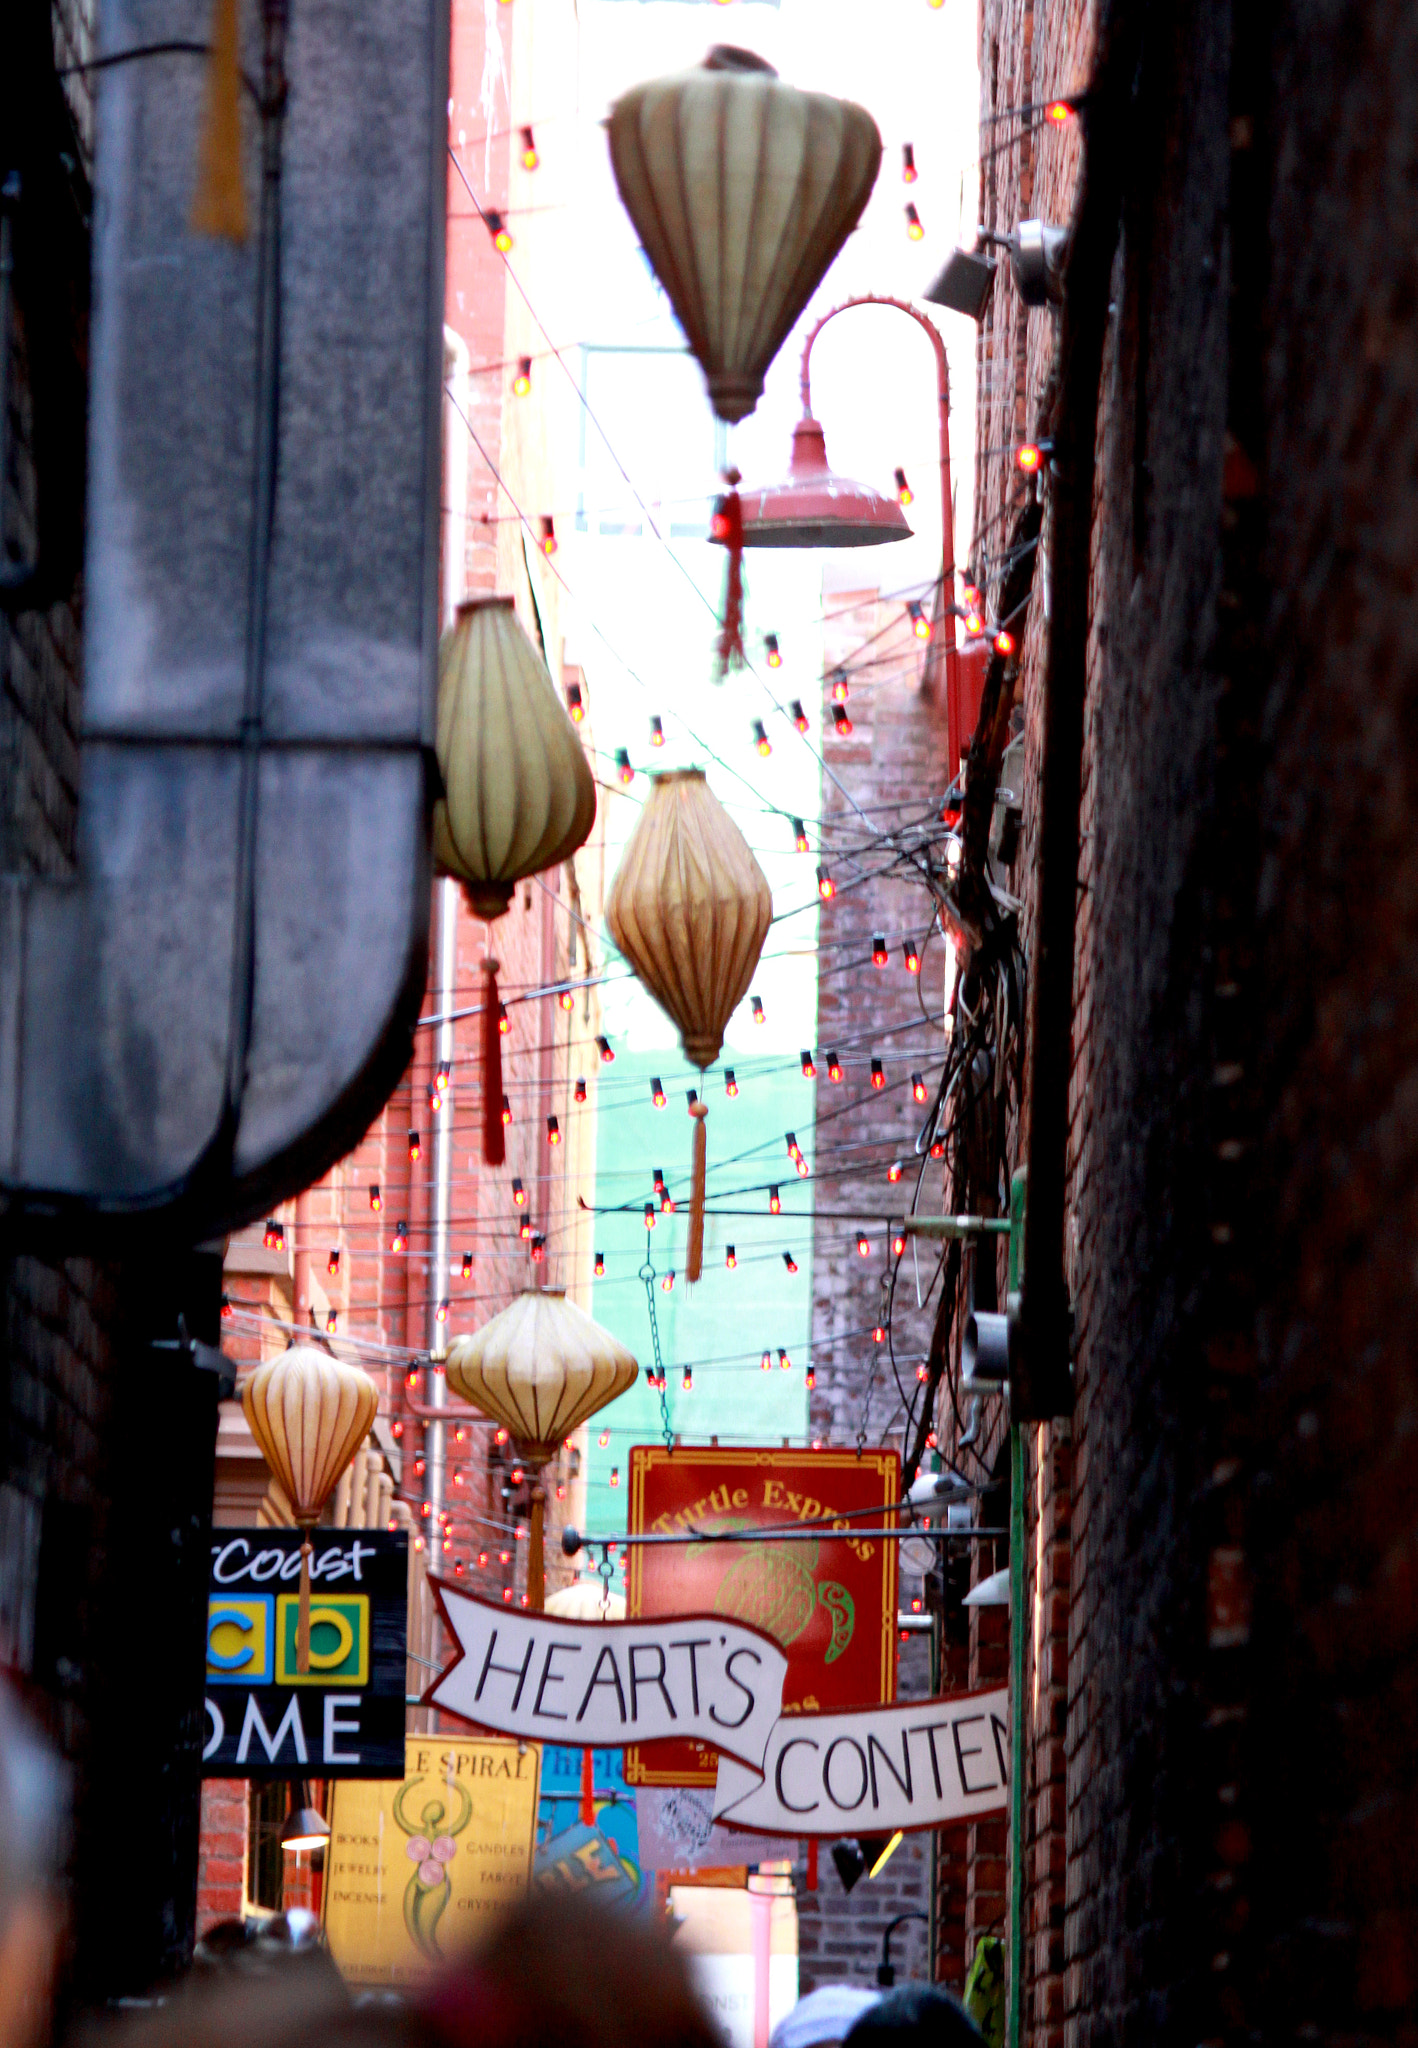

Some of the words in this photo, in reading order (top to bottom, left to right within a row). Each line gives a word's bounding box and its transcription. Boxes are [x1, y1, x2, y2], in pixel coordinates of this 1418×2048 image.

[651, 1484, 748, 1535] Turtle
[213, 1538, 376, 1583] Coast
[474, 1629, 762, 1728] HEART'S
[438, 1751, 529, 1780] SPIRAL
[336, 1833, 379, 1846] BOOKS
[466, 1841, 525, 1857] CANDLES
[333, 1863, 387, 1877] JEWELRY
[480, 1871, 522, 1885] TAROT
[333, 1891, 387, 1904] INCENSE
